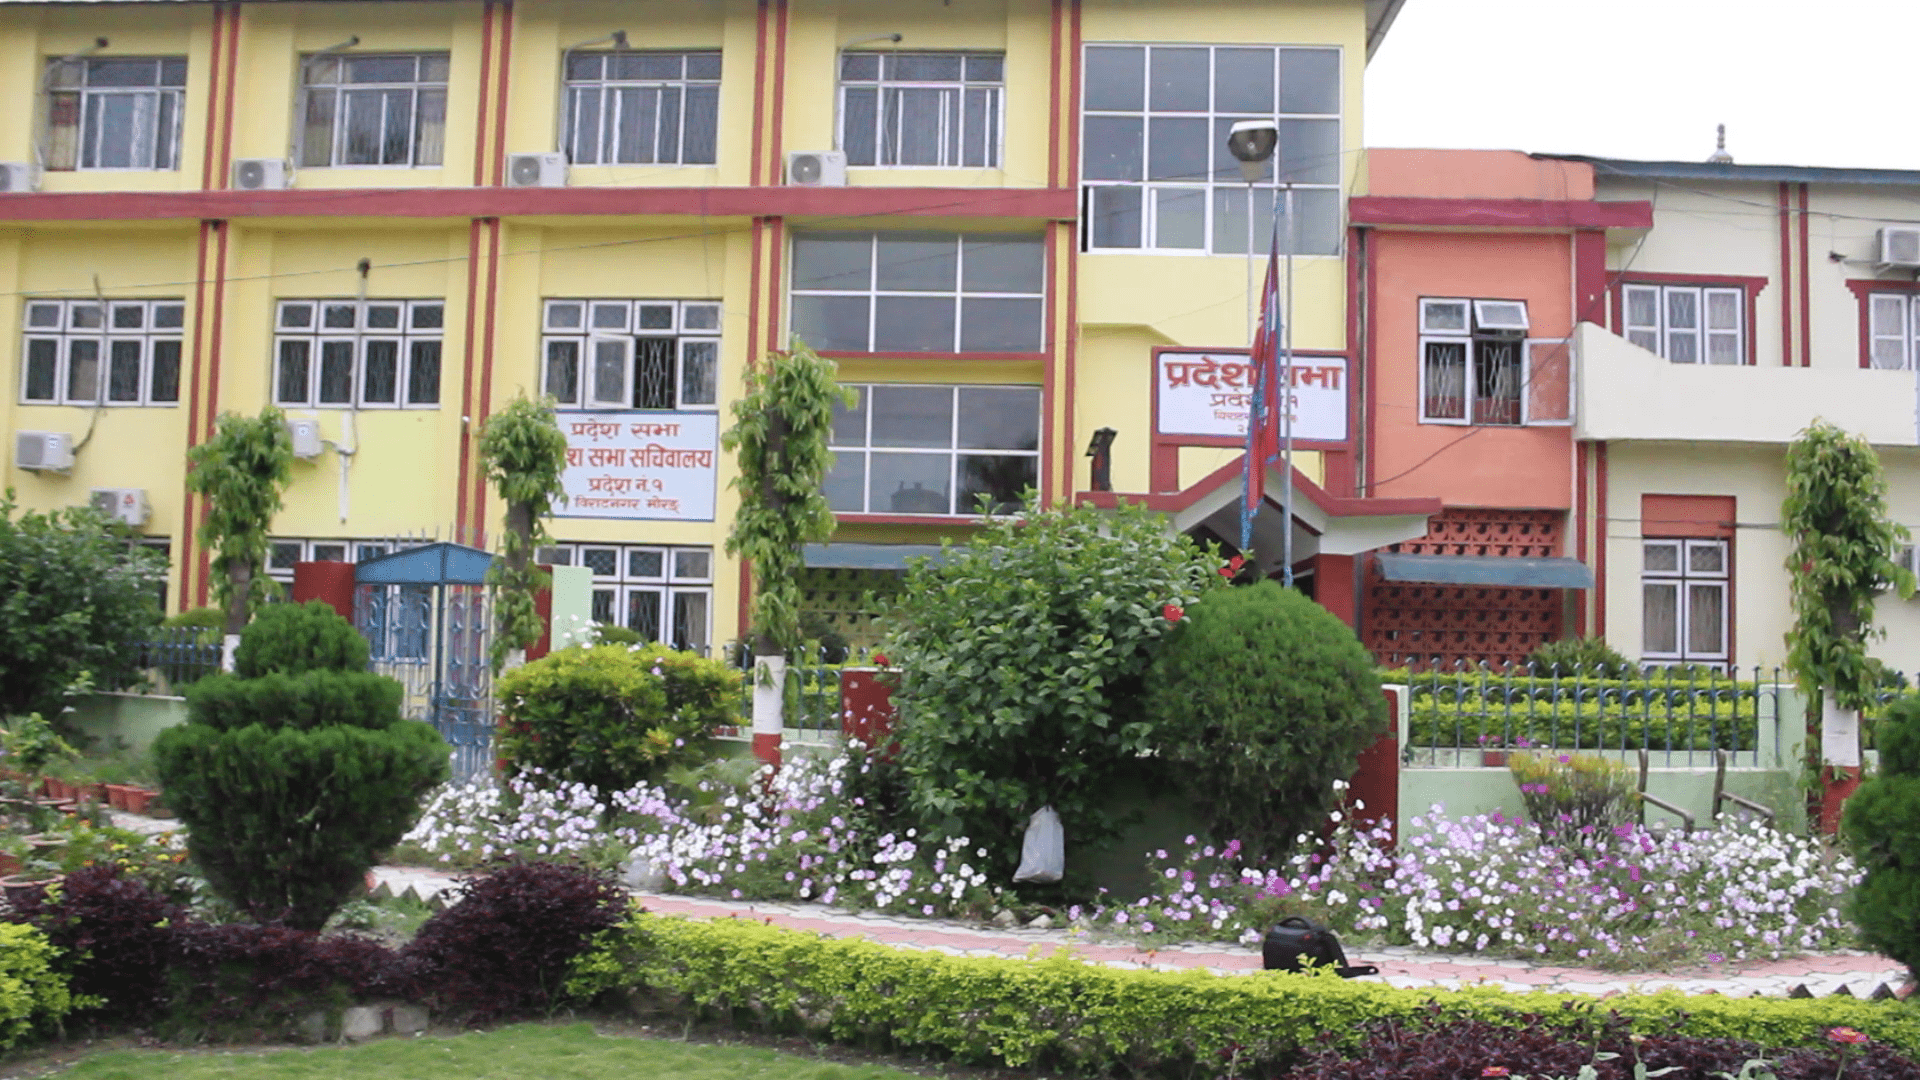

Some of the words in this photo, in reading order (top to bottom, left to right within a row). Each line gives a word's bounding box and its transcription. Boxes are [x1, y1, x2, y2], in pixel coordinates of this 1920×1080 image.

[1164, 356, 1257, 389] प्रदेश
[570, 418, 621, 441] प्रदेश
[630, 423, 680, 439] सभा
[588, 448, 626, 467] सभा
[630, 443, 712, 468] सचिवालय
[588, 474, 632, 496] प्रदेश
